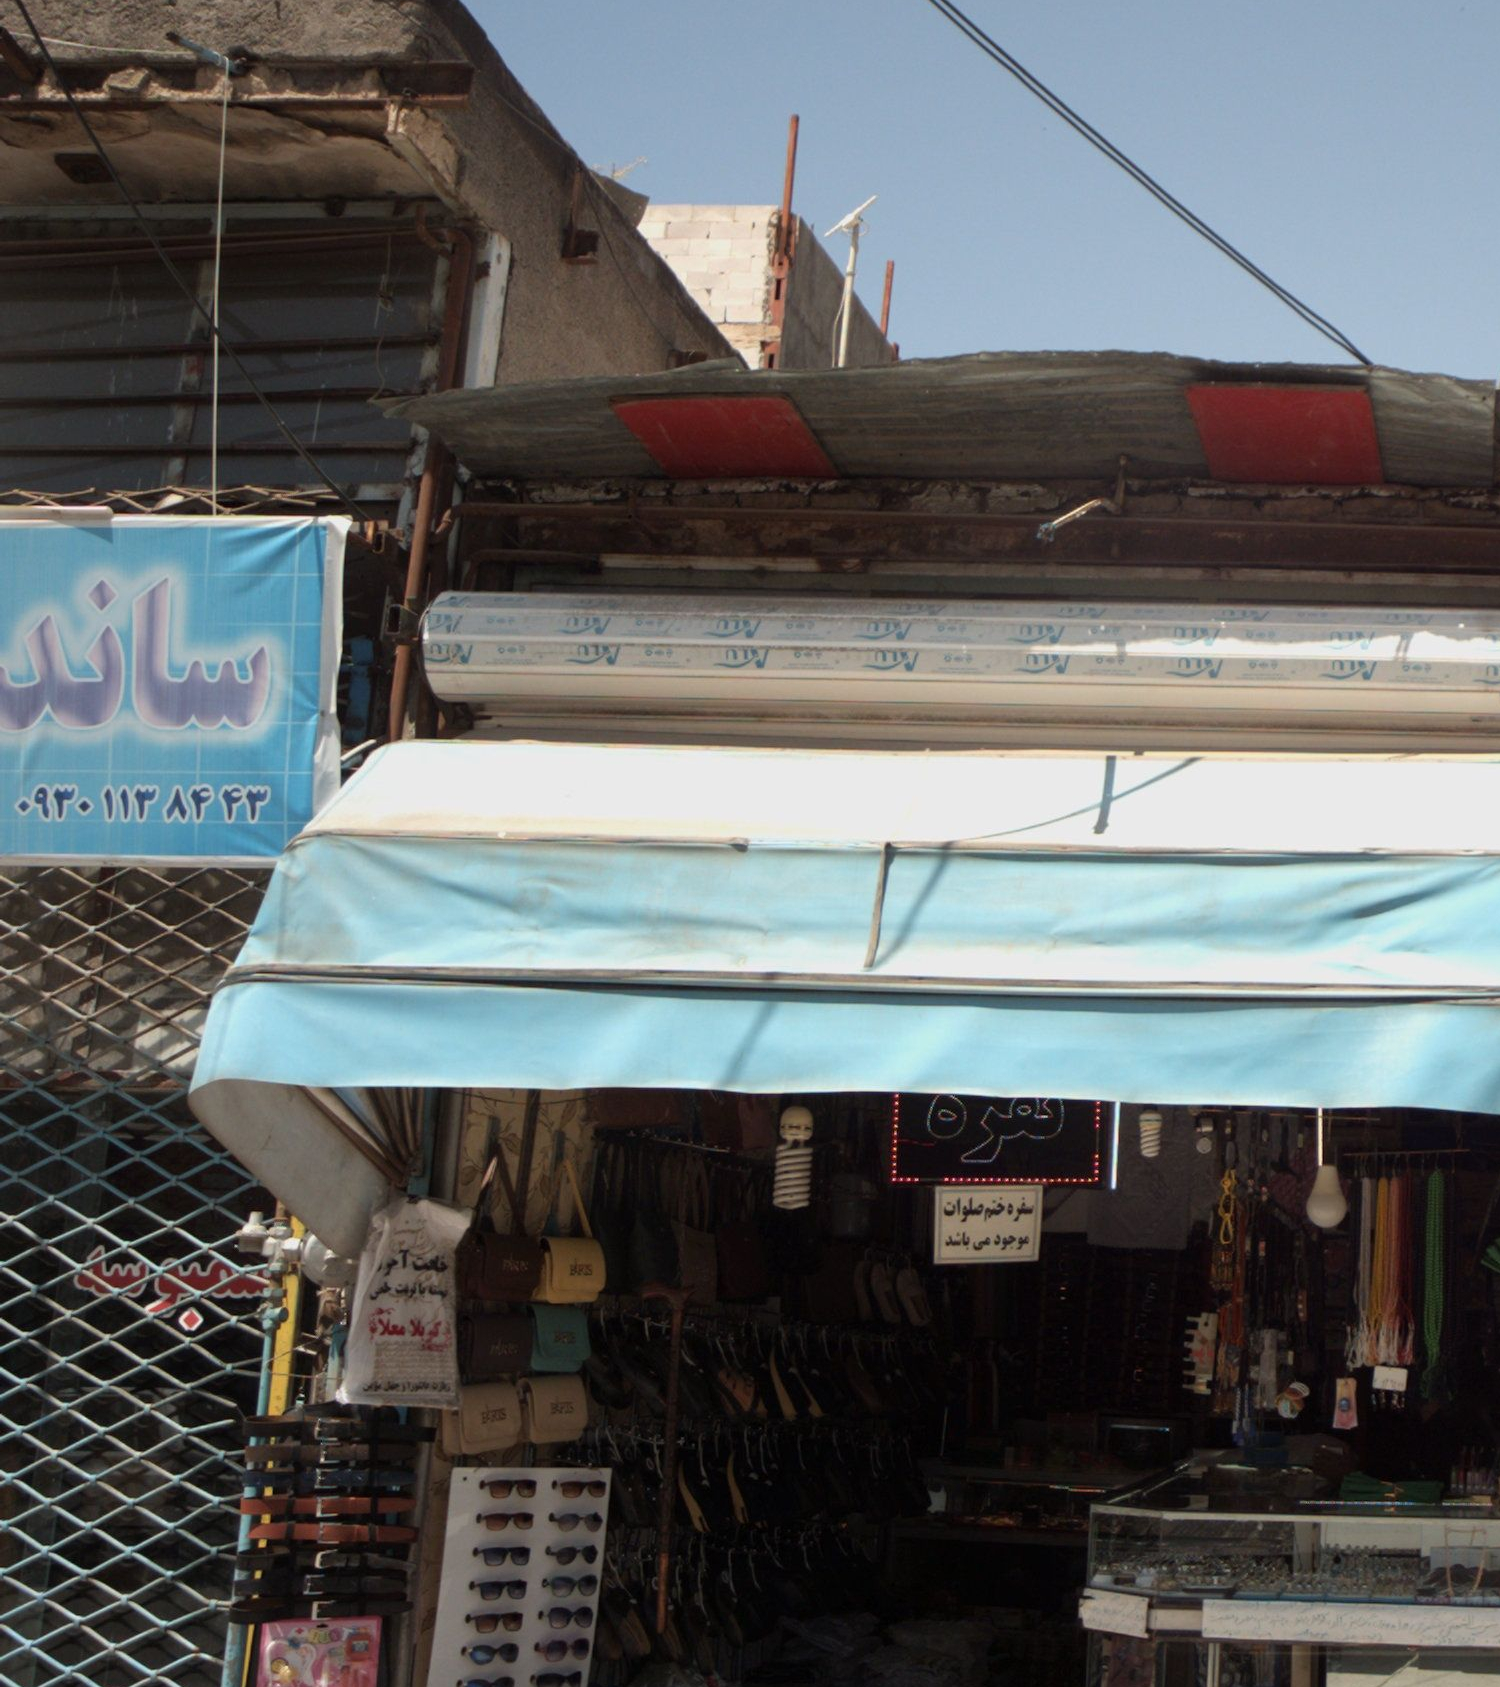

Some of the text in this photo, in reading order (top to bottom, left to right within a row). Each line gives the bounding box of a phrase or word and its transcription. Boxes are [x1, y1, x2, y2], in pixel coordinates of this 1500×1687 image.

[944, 1197, 1033, 1221] سفره ختم صلوات
[945, 1232, 1029, 1251] موجود می باشد
